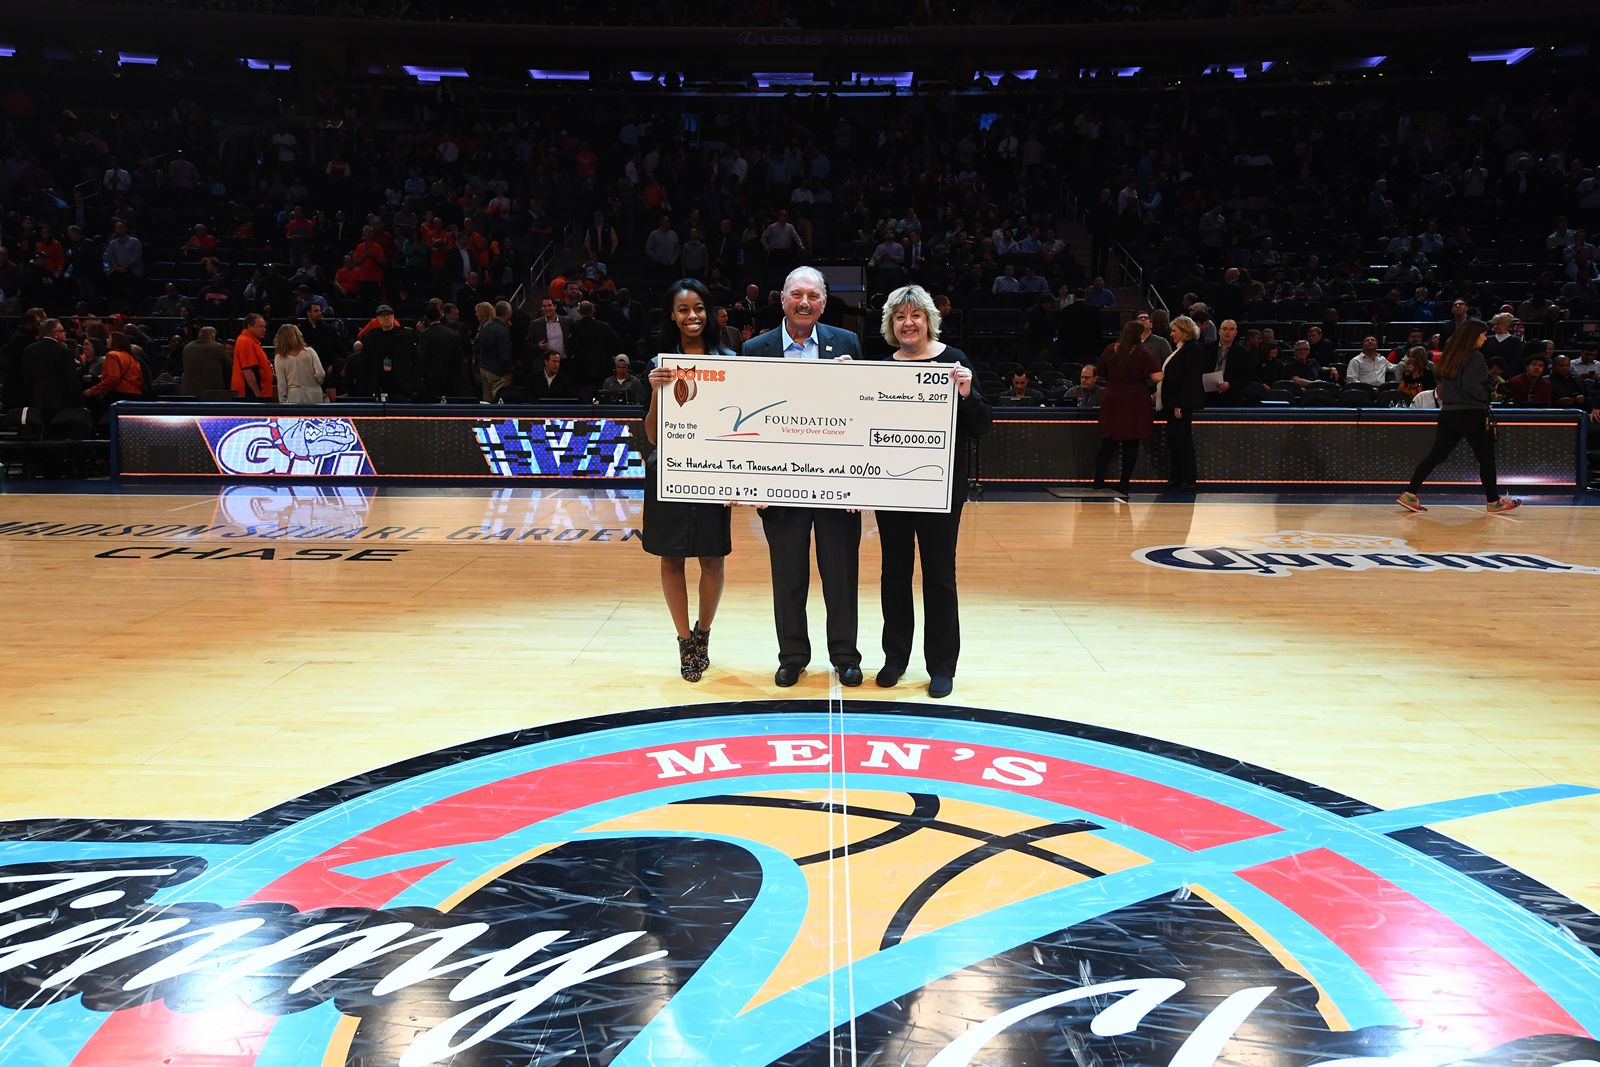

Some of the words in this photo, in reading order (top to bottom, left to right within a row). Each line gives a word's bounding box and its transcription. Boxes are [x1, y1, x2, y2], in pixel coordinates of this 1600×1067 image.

[915, 372, 949, 385] 1205
[878, 391, 915, 400] December
[928, 393, 948, 401] 2017
[664, 421, 677, 430] Pay
[678, 422, 685, 430] to
[686, 421, 698, 430] the
[764, 415, 847, 426] FOUNDATION
[666, 431, 685, 440] Order
[686, 432, 696, 440] Of
[781, 427, 805, 435] Victory
[805, 427, 821, 435] Over
[873, 431, 941, 445] $610,000.00
[666, 457, 682, 468] Six
[686, 457, 723, 470] Hundred
[726, 459, 743, 470] Ten
[745, 460, 788, 472] Thousand
[790, 462, 825, 473] Dollars
[828, 465, 846, 474] and
[849, 462, 881, 476] 00/00
[94, 547, 412, 562] CHASE
[1144, 546, 1573, 574] Corona
[646, 739, 1047, 787] MEN'S
